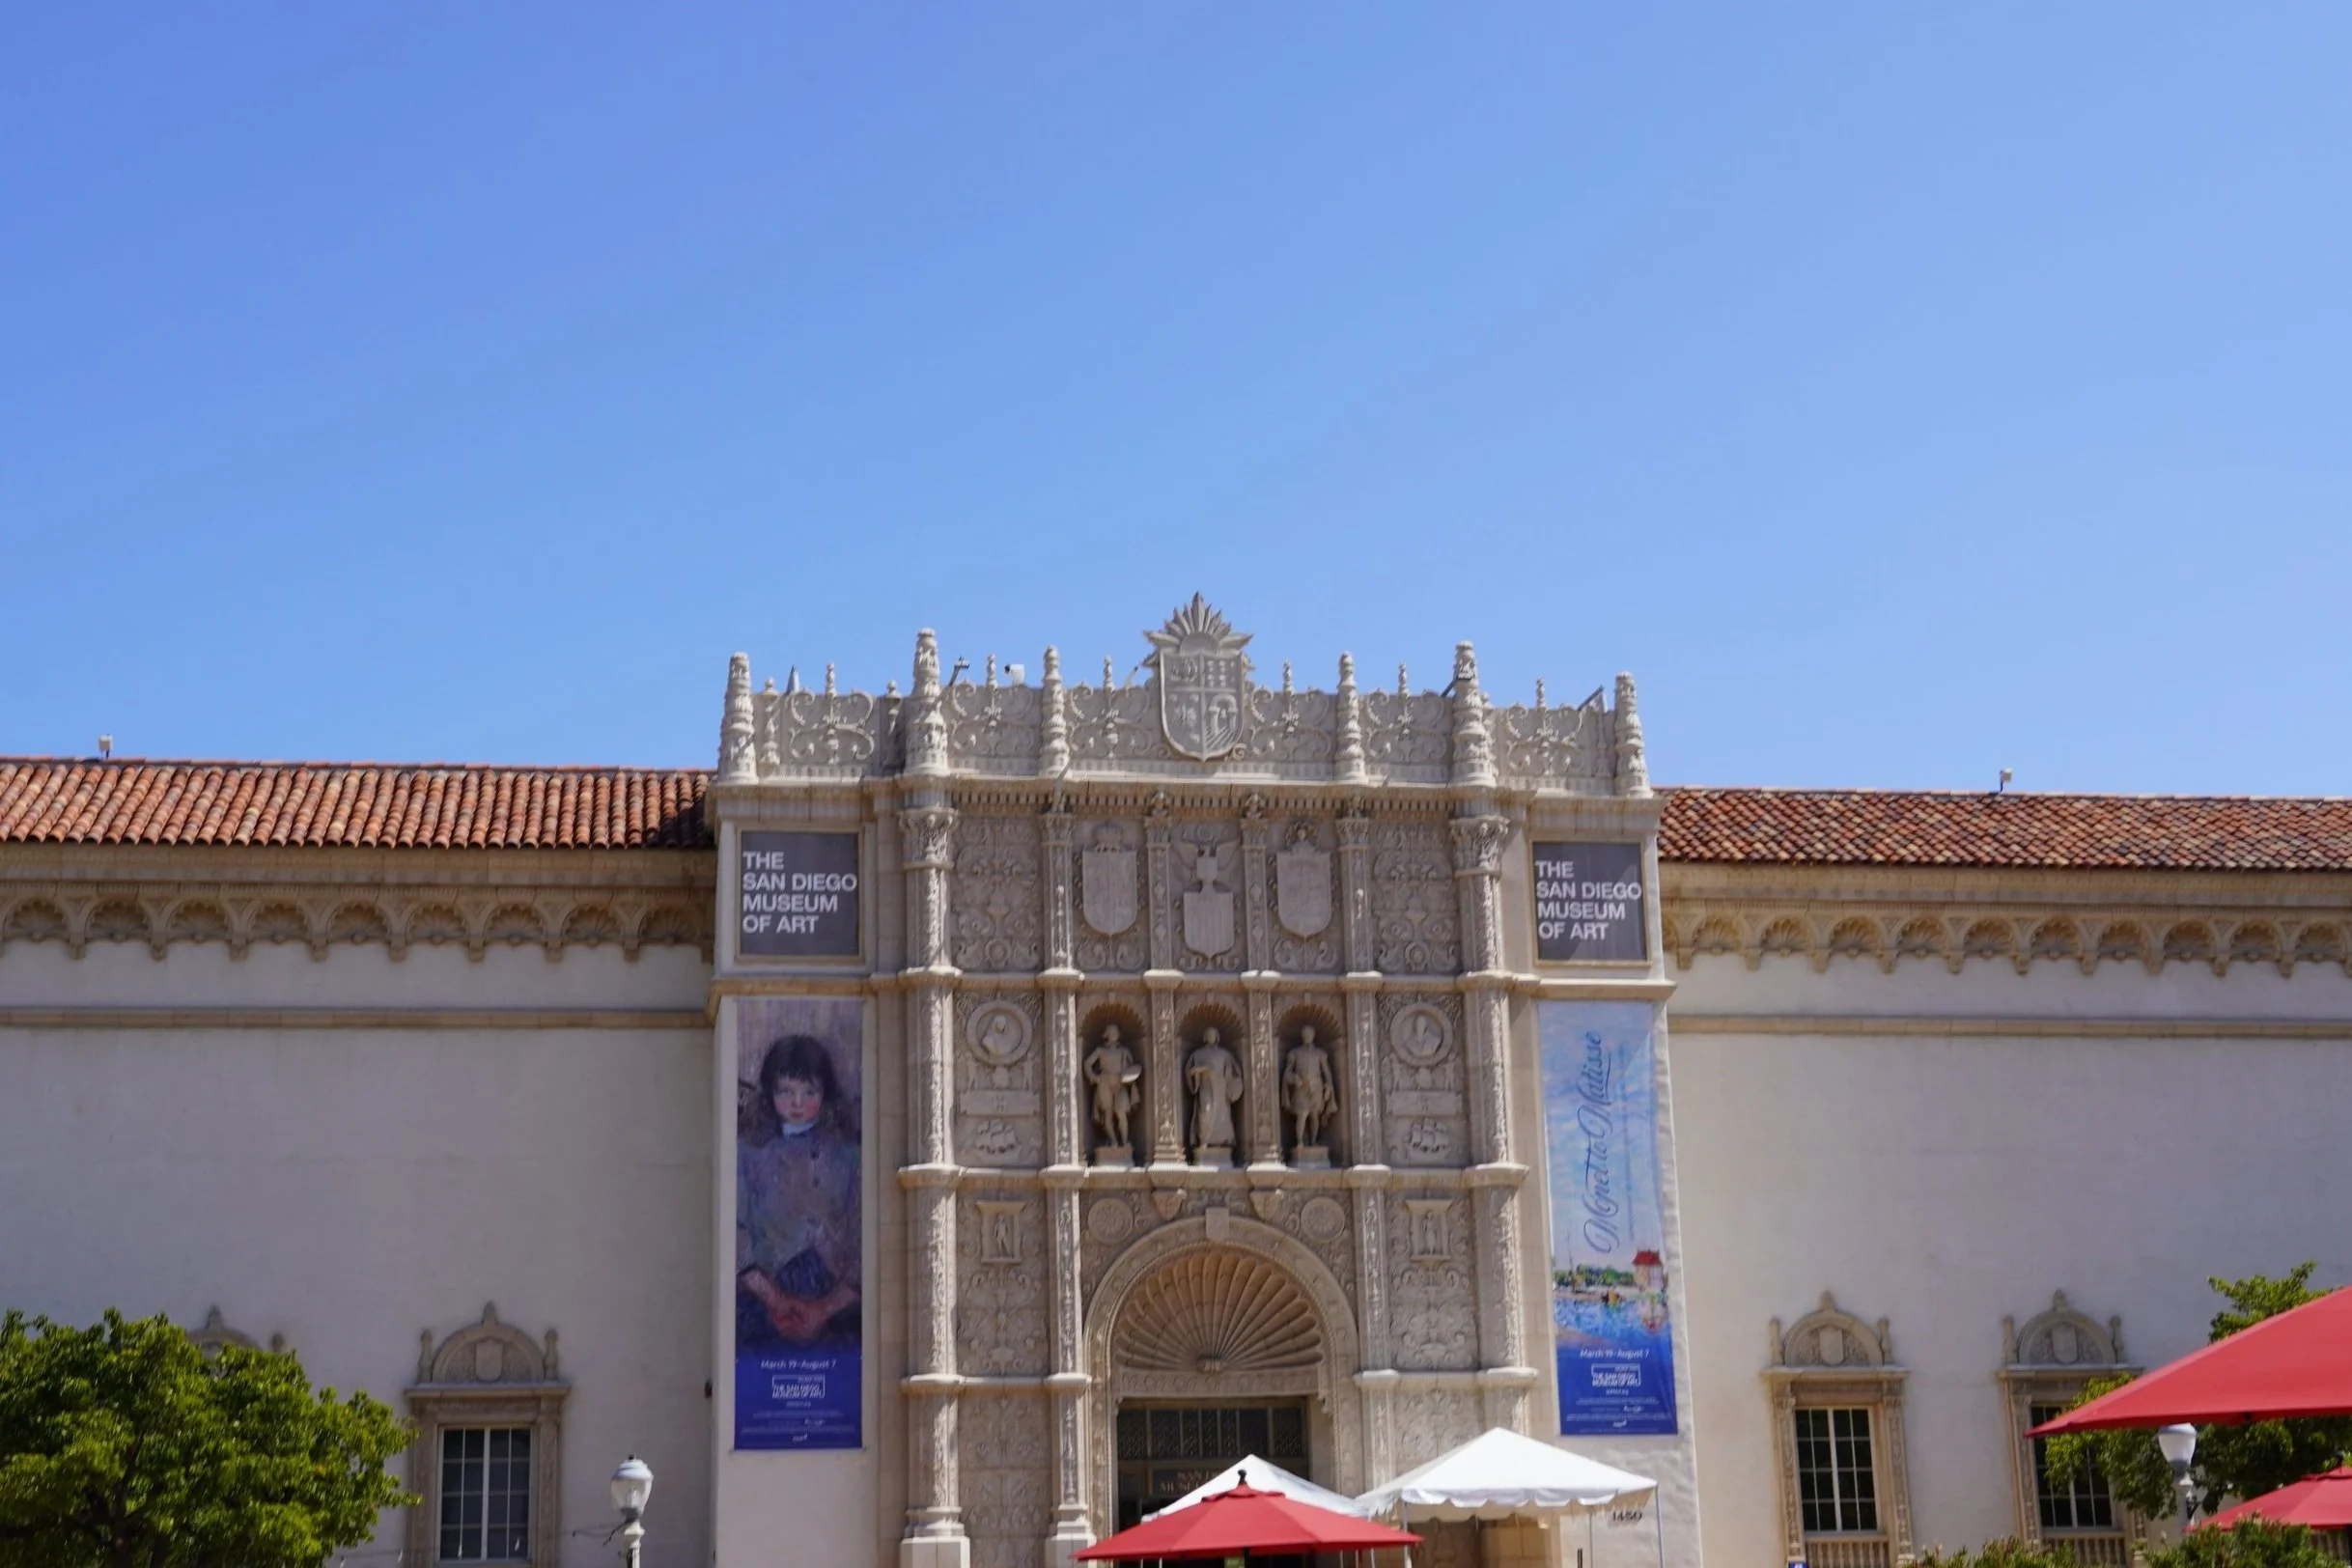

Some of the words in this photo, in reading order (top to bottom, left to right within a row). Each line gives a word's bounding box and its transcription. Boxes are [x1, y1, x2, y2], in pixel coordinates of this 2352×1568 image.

[742, 851, 785, 870] THE
[1534, 860, 1575, 879] THE
[742, 872, 786, 891] SAN
[792, 873, 858, 892] DIEGO
[1536, 881, 1576, 899] SAN
[1582, 882, 1642, 900] DIEGO
[742, 893, 838, 912] MUSEUM
[1537, 901, 1626, 920] MUSEUM
[742, 914, 771, 934] OF
[776, 915, 820, 934] ART
[1538, 921, 1565, 939] OF
[1570, 922, 1609, 940] ART
[1577, 1030, 1613, 1140] Matisse
[1582, 1162, 1619, 1254] Monet
[1580, 1349, 1604, 1358] March
[761, 1359, 787, 1369] March
